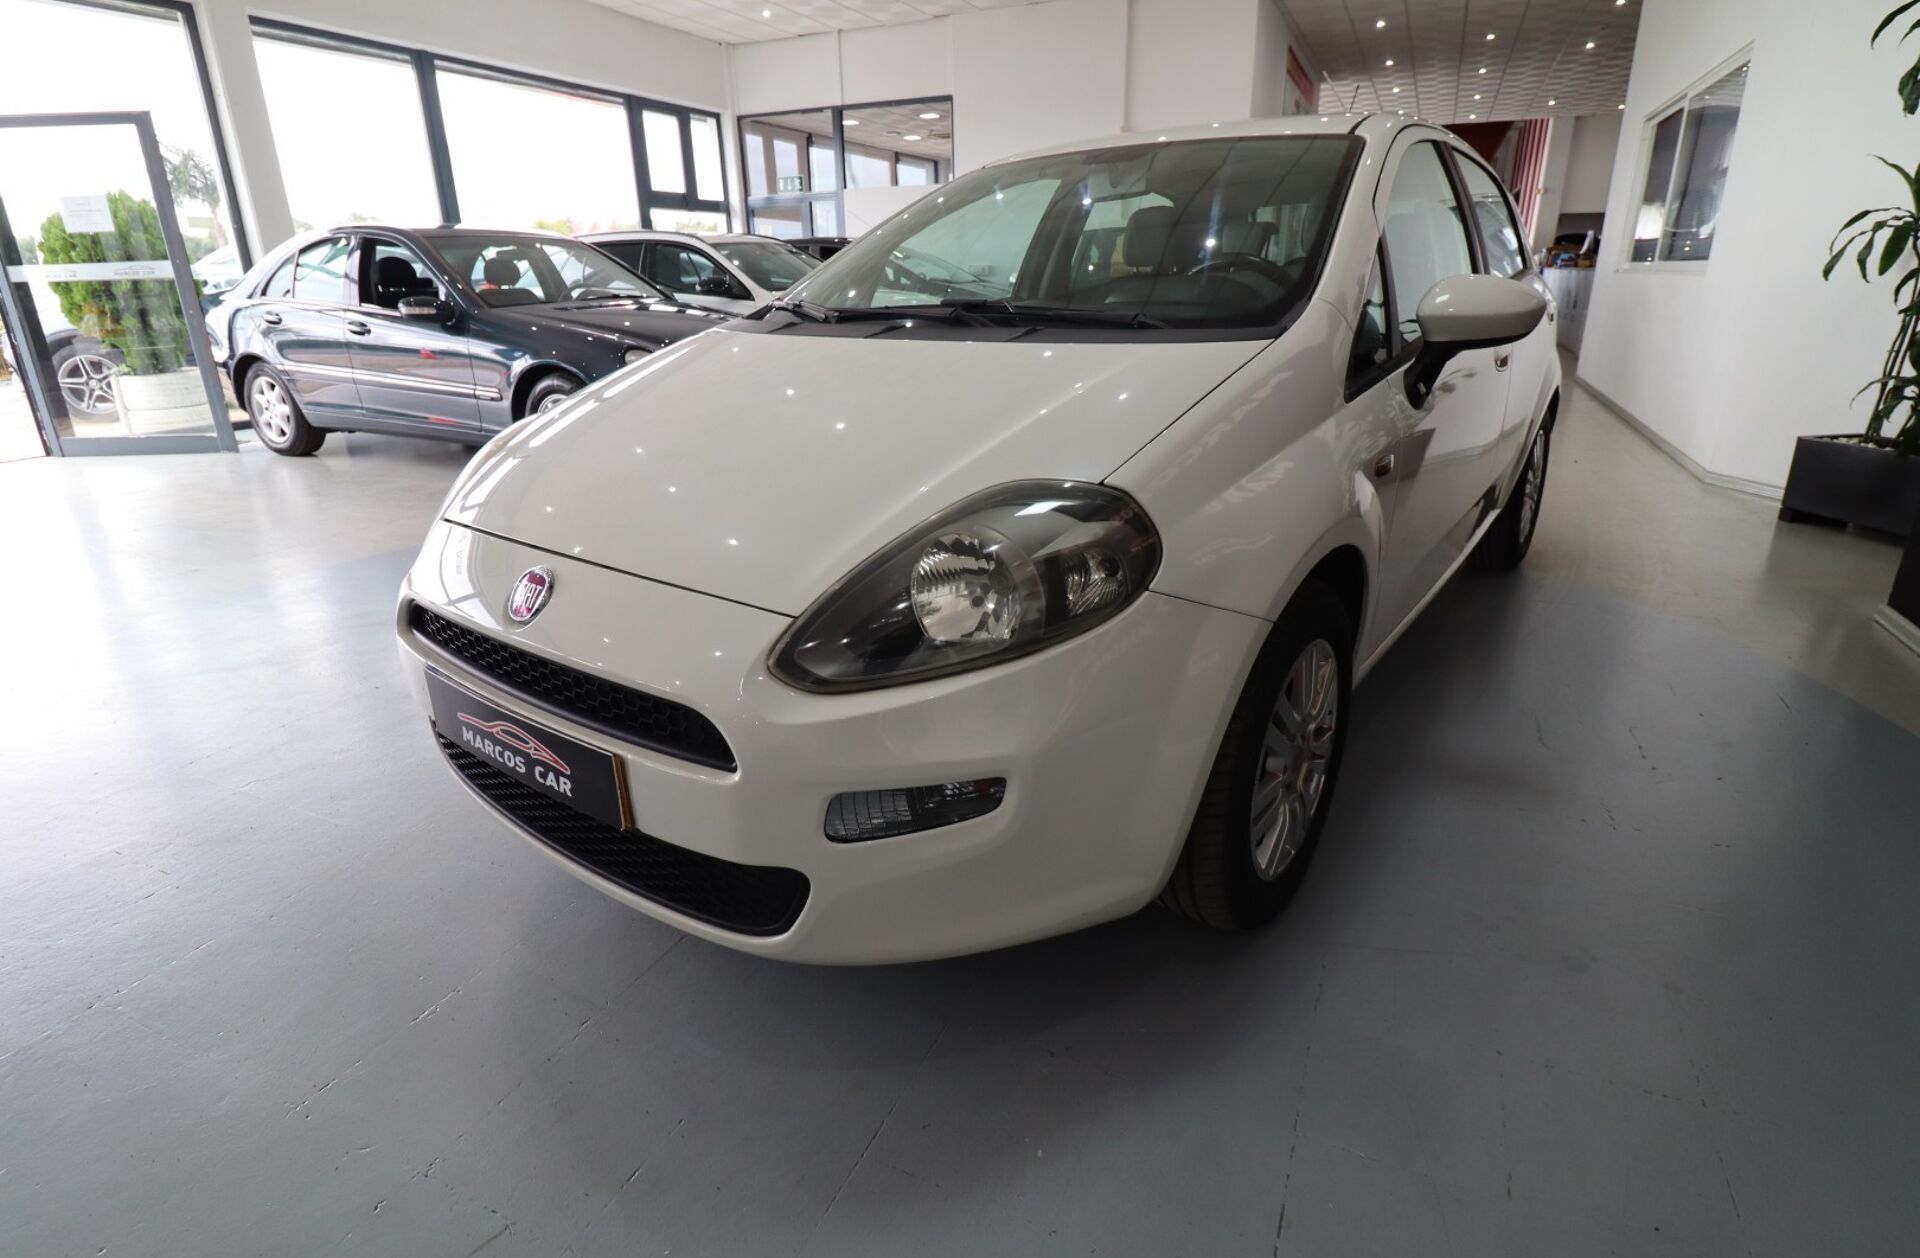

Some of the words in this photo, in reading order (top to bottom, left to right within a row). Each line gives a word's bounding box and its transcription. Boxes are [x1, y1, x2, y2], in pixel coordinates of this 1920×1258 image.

[513, 577, 543, 610] FIAT
[462, 727, 526, 774] MARCOS
[534, 766, 573, 797] CAR
